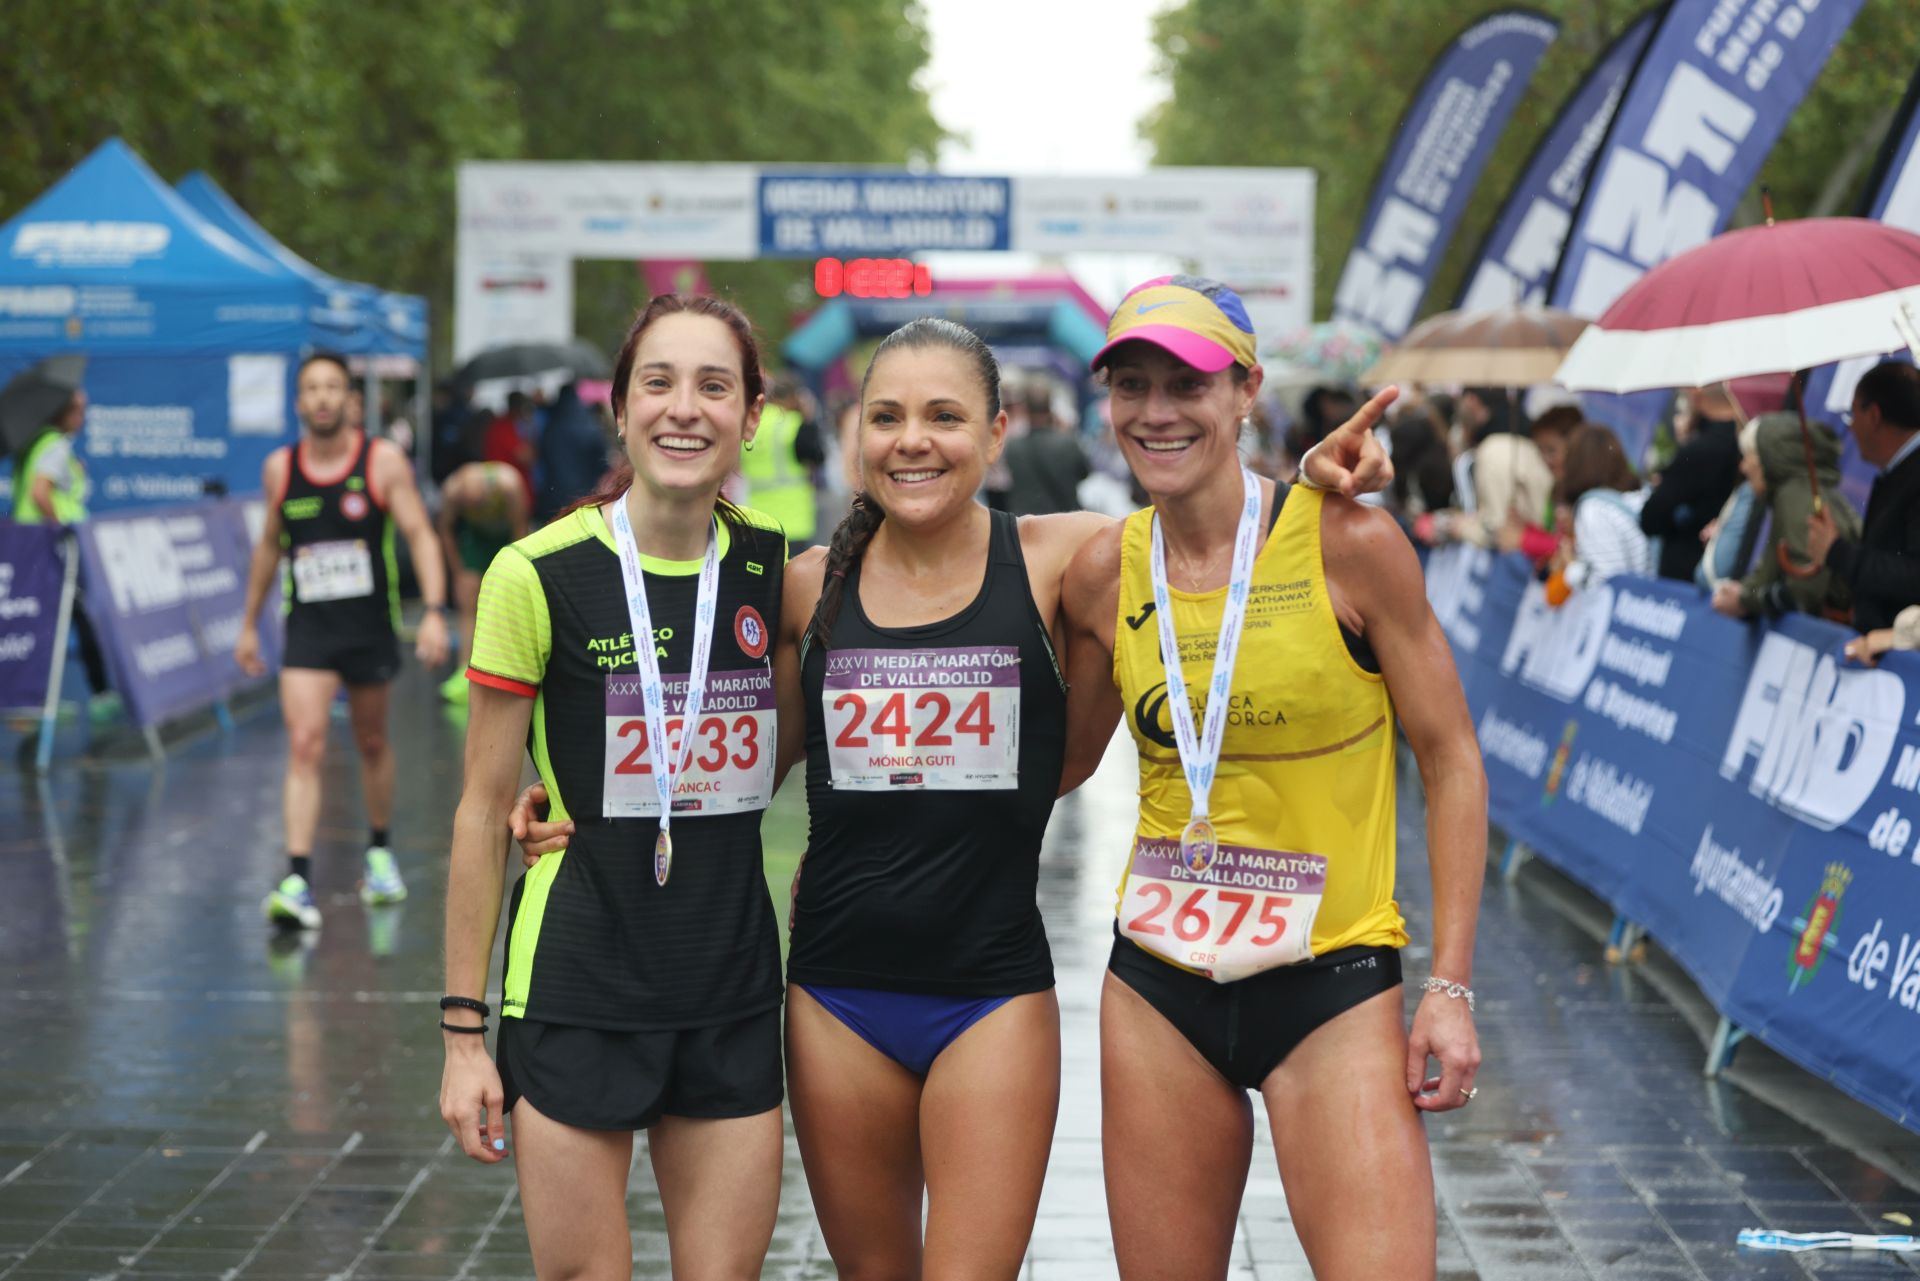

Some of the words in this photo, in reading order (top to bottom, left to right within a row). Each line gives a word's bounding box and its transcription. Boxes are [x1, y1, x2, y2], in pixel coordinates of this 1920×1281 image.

[587, 627, 674, 652] ATLÉCO
[597, 645, 669, 668] PUCEA
[829, 655, 869, 672] XXXVI
[874, 653, 928, 669] MEDIA
[933, 649, 1015, 668] MARATÓN
[711, 673, 771, 693] MARATÓN
[860, 672, 882, 687] DE
[886, 671, 993, 687] VALLADOLID
[672, 695, 758, 714] VLADOLID
[833, 691, 996, 748] 2424
[868, 754, 924, 768] MÓNICA
[925, 755, 956, 767] GUTI
[671, 780, 712, 794] LANCA
[713, 780, 722, 793] C
[1868, 806, 1912, 857] de
[1238, 855, 1324, 875] MARATÓN
[1170, 864, 1191, 879] DE
[1195, 870, 1298, 891] VALLADOLID
[1127, 882, 1293, 947] 2675
[1189, 952, 1217, 964] CRIS
[1847, 918, 1890, 991] de
